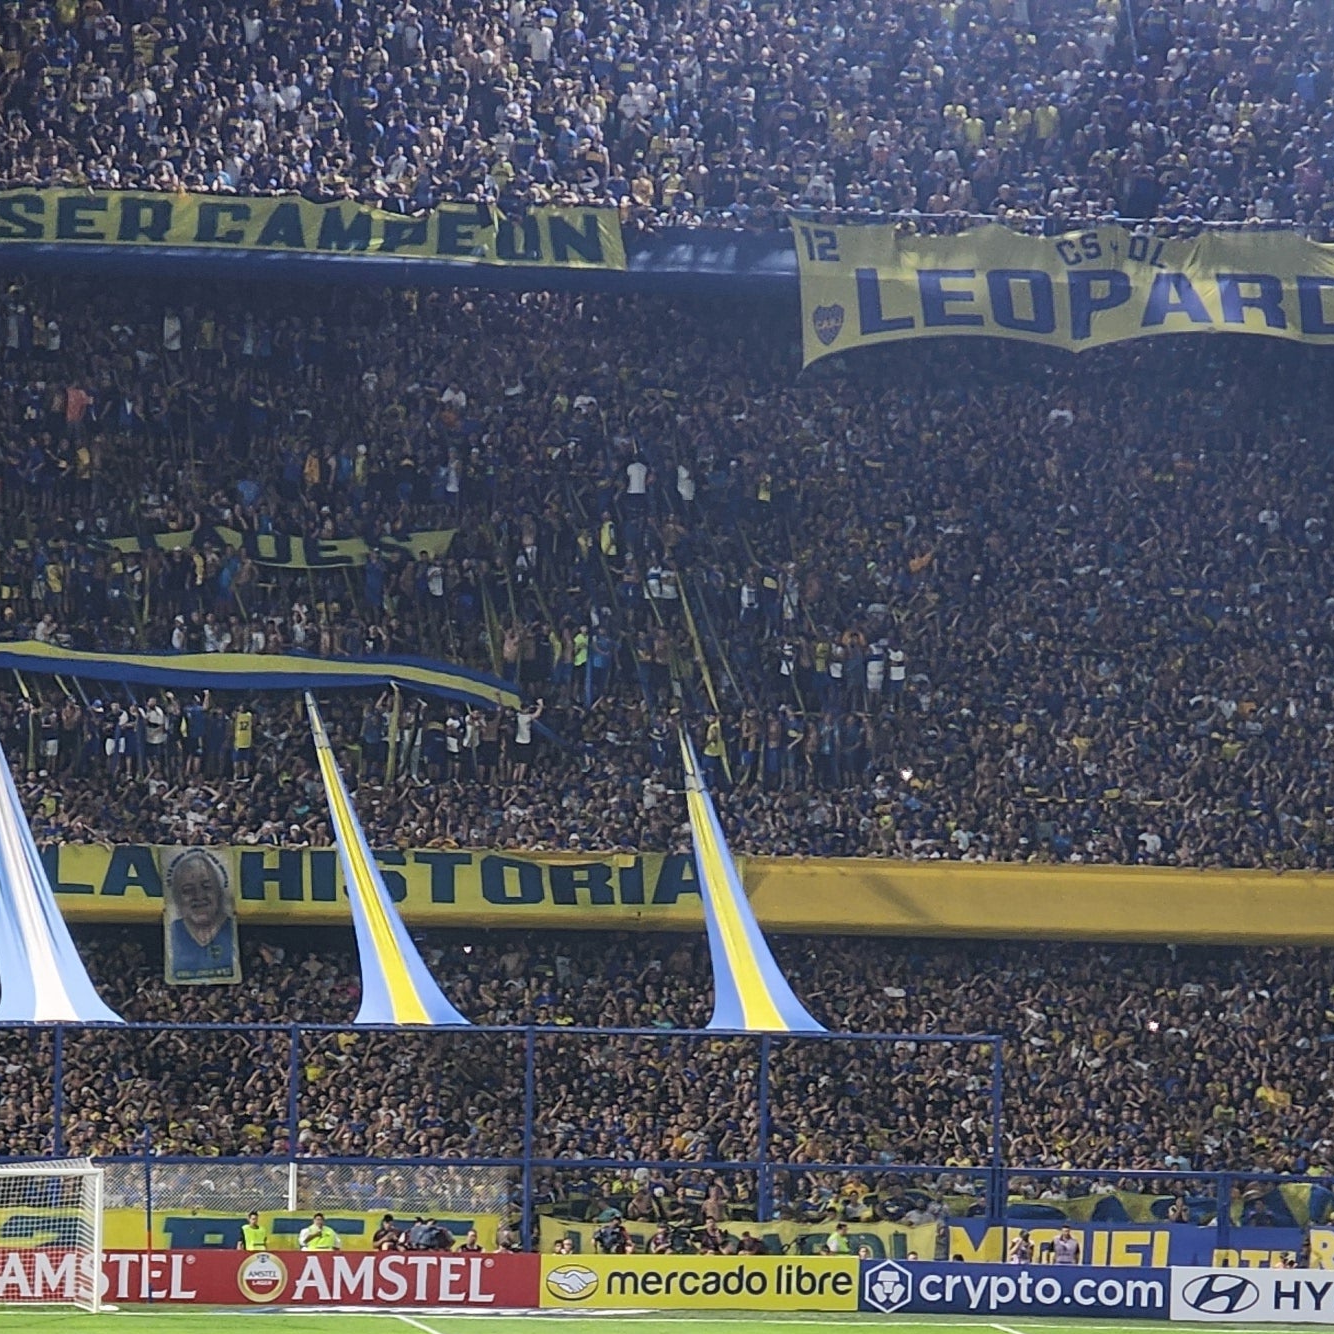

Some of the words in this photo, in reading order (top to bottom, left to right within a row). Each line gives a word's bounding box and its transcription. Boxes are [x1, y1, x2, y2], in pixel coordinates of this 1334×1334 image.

[800, 226, 840, 262] 12
[41, 844, 163, 897] LA
[240, 849, 703, 906] HISTORIA
[248, 1270, 277, 1278] AMSTEL
[293, 1255, 496, 1303] AMSTEL
[607, 1264, 768, 1297] mercado
[776, 1263, 854, 1297] libre
[919, 1268, 1165, 1310] crypto.com
